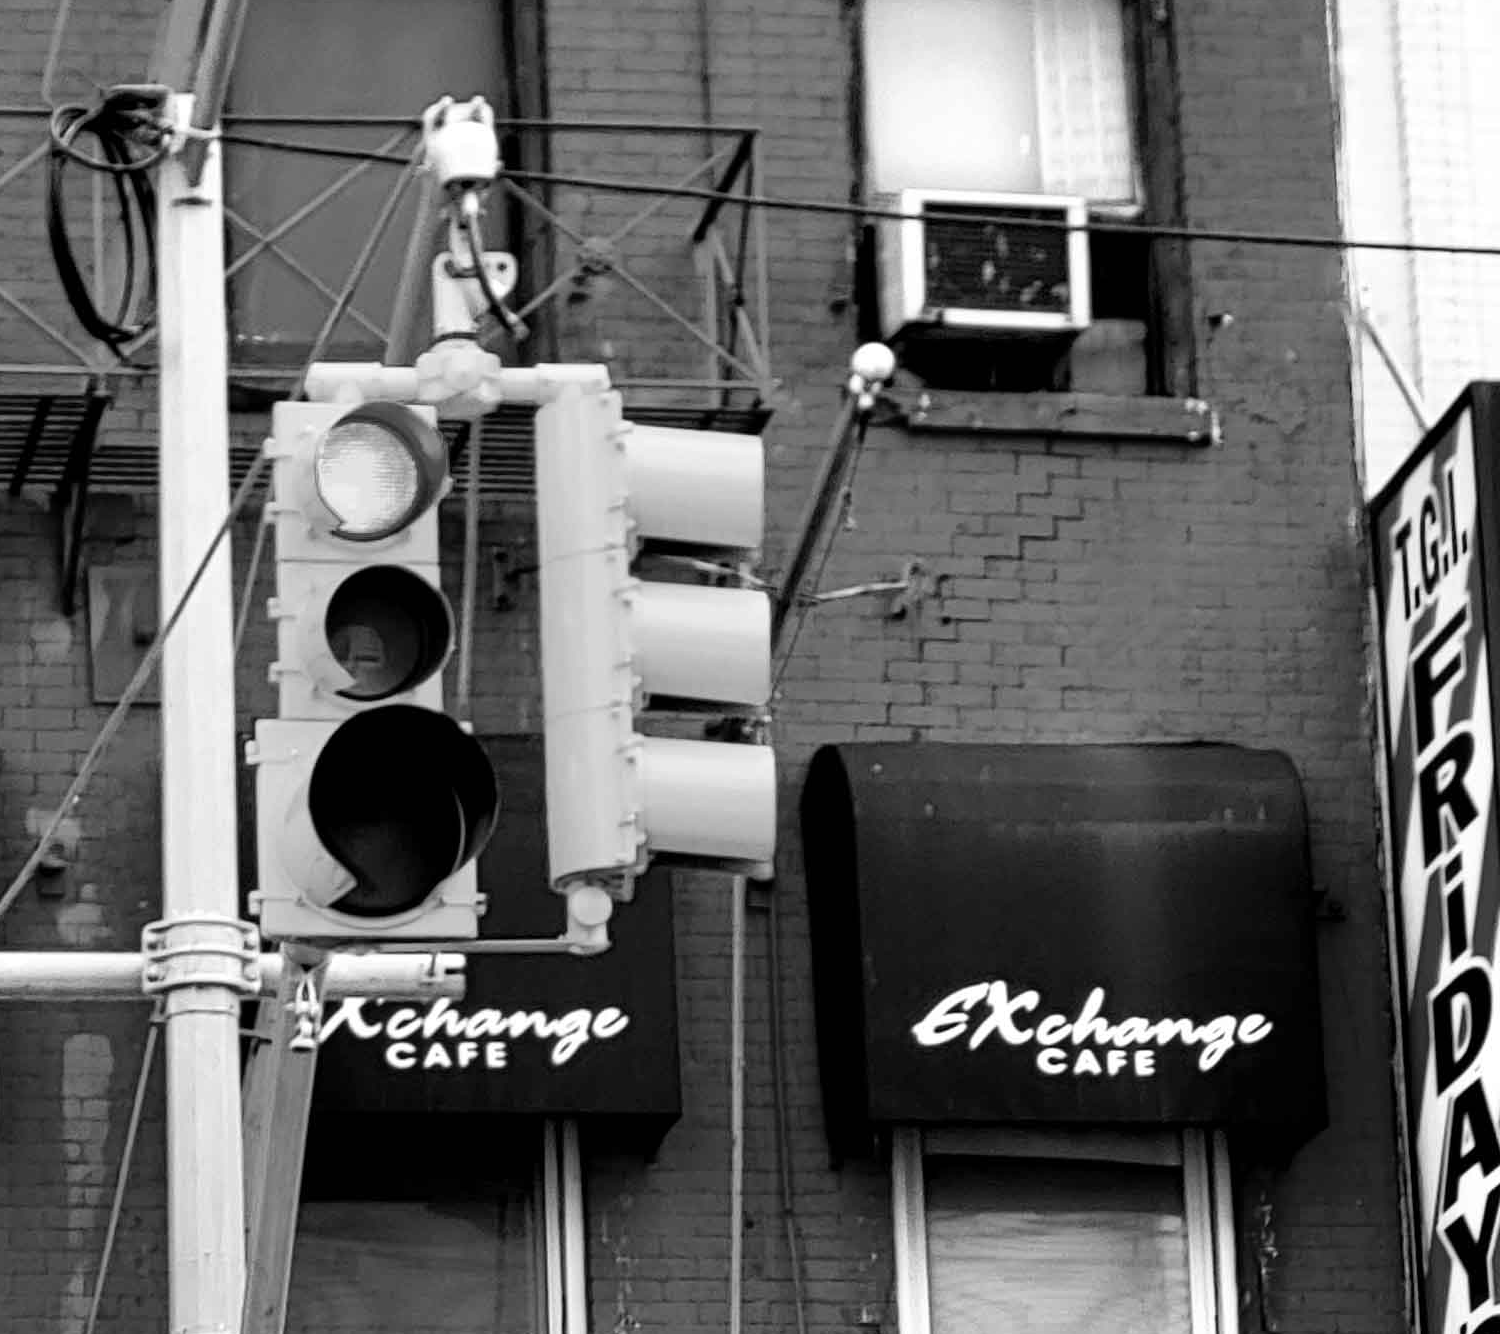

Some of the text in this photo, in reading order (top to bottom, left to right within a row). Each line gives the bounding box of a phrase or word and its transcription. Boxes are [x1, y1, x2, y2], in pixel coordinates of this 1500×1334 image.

[1394, 467, 1468, 622] T.G.I.
[385, 1041, 508, 1068] CAFE
[1036, 1048, 1156, 1076] CAFE
